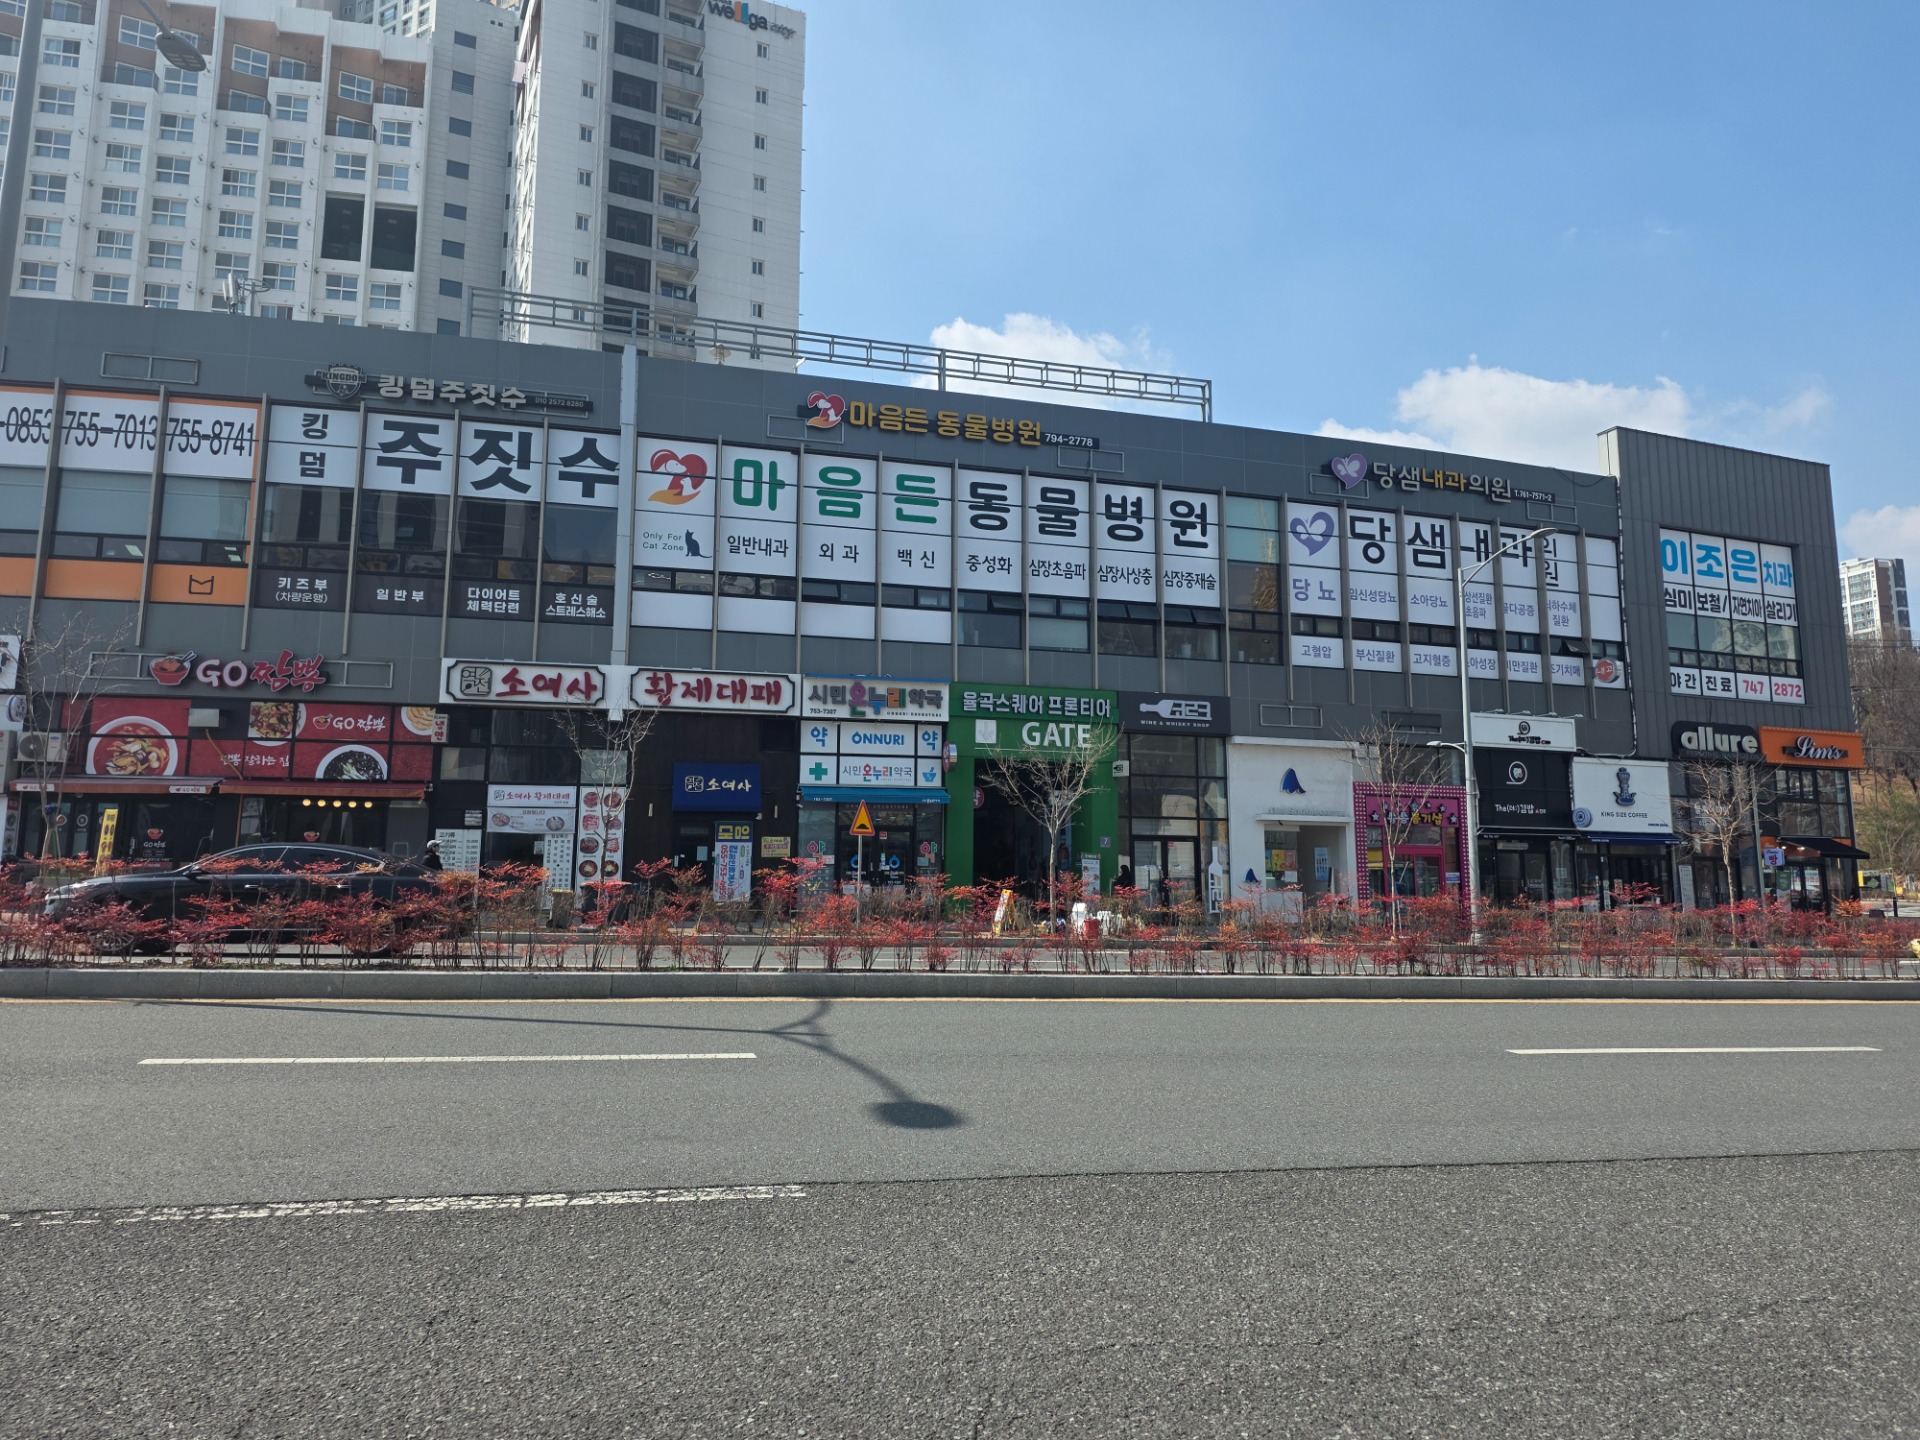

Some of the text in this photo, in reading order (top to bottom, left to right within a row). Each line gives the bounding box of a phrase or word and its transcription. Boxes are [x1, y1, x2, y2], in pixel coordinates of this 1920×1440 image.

[378, 374, 527, 409] 킹덤주짓수
[64, 411, 158, 450] 755-7013
[850, 401, 1041, 446] 마음든 동물병원
[168, 417, 254, 457] 755-8741
[300, 412, 330, 478] 킹덤
[1045, 433, 1093, 447] 794-2778
[376, 419, 620, 499] 주짓수
[732, 458, 940, 524] 마음든
[1373, 460, 1511, 503] 당샘내과의원
[968, 481, 1209, 549] 동물병원
[642, 531, 682, 542] Only For
[642, 541, 685, 552] Cat Zone
[727, 535, 788, 558] 일반내과
[966, 554, 1012, 574] 중성화
[1029, 558, 1086, 580] 심장초음파
[1661, 538, 1793, 588] 이조은 치과
[278, 577, 327, 590] 키즈부
[1097, 564, 1153, 586] 심장사상충
[1163, 569, 1217, 591] 심장중재술
[275, 591, 328, 604] (차량운행)
[376, 588, 425, 602] 일반부
[467, 587, 520, 601] 다이어트
[1410, 594, 1448, 608] 소아당뇨
[1664, 587, 1693, 610] 심미
[1732, 596, 1763, 619] 자연치아
[1766, 601, 1798, 622] 살리기
[466, 600, 520, 614] 체력단련
[545, 604, 607, 618] 스트레스해소
[1552, 615, 1570, 628] 질환
[1301, 644, 1332, 660] 고혈압
[1355, 648, 1395, 663] 부신질환
[1413, 653, 1451, 667] 고지혈증
[196, 648, 327, 692] GO 짬뽕
[495, 667, 598, 700] 소여사
[644, 671, 782, 706] 황제대패
[1705, 675, 1733, 693] 진료
[1742, 680, 1803, 698] 747 2872
[808, 681, 944, 717] 시민온누리약국
[962, 691, 1111, 718] 율곡스퀘어 프론티어
[809, 707, 837, 716] 753-7307
[333, 714, 386, 732] GO 짬뽕
[810, 726, 828, 748] 약
[851, 731, 905, 746] ONNURI
[921, 730, 939, 751] 약
[1021, 721, 1092, 748] GATE
[1681, 727, 1758, 754] allure
[842, 763, 913, 783] 시민온누리약국
[705, 777, 752, 792] 소여사
